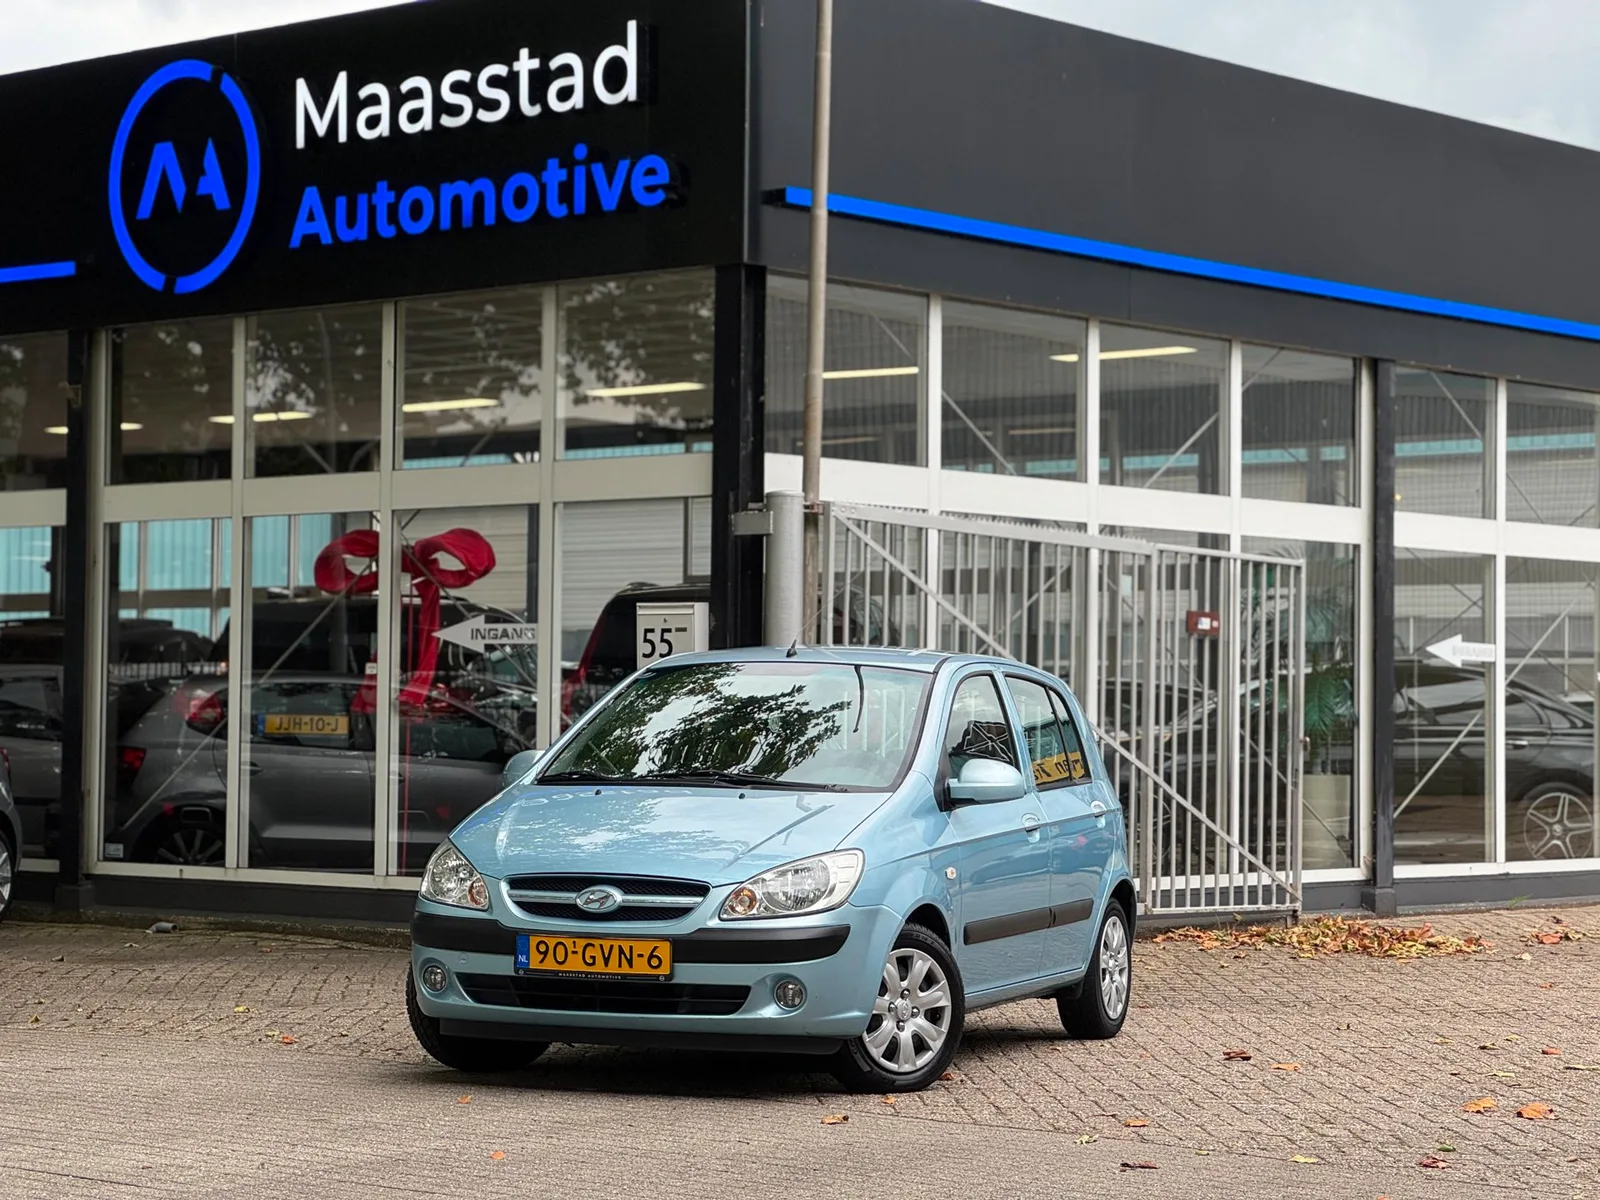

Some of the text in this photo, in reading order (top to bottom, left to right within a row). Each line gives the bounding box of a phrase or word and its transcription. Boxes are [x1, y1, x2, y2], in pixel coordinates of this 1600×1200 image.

[295, 19, 637, 149] Maasstad
[289, 143, 670, 249] Automotive
[642, 627, 673, 659] 55
[275, 717, 339, 732] JJH-10-J
[518, 954, 528, 963] NL
